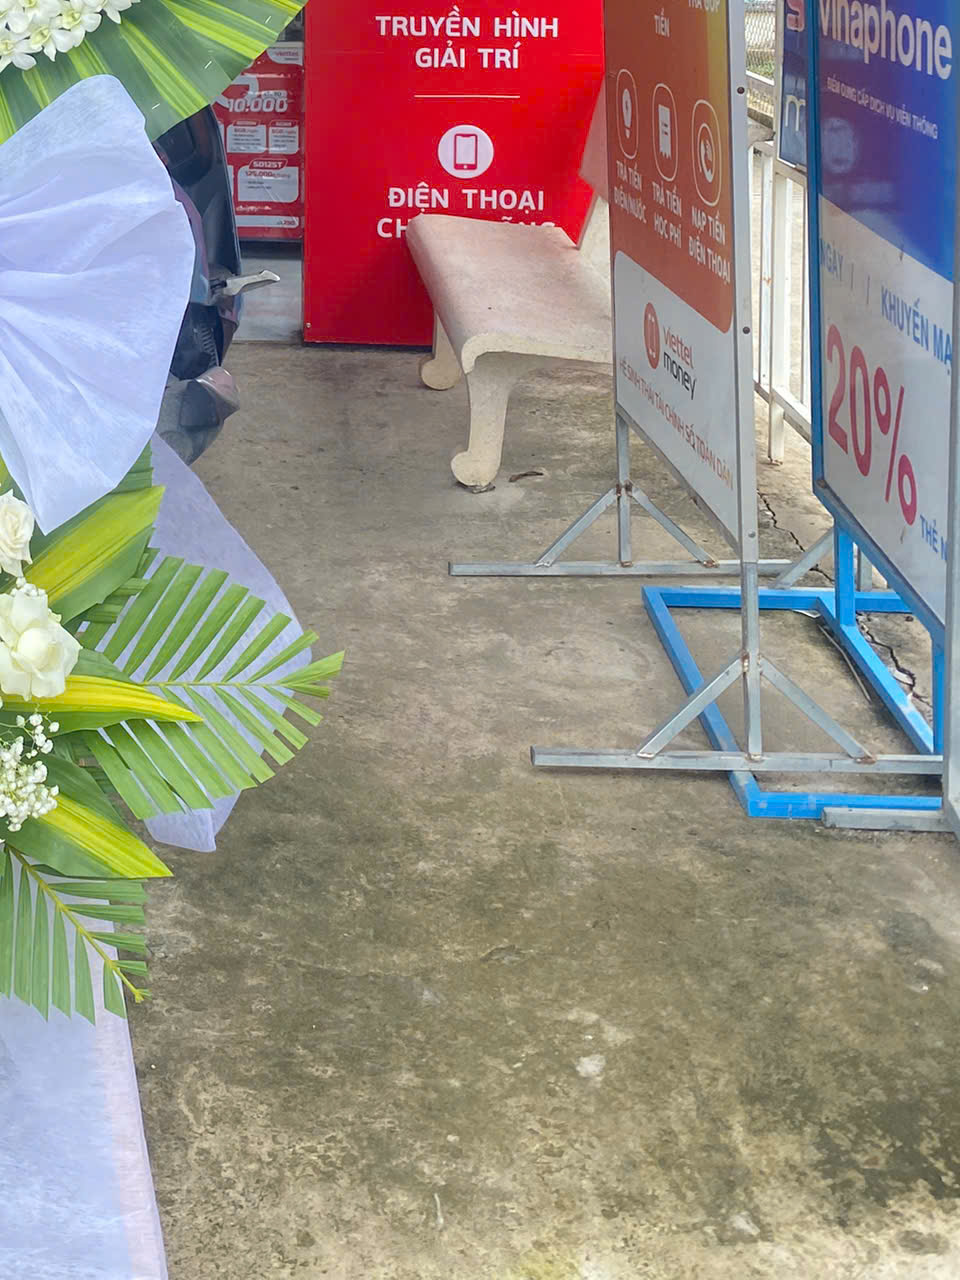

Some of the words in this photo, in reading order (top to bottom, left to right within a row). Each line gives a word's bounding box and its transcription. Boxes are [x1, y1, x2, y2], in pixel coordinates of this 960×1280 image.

[376, 5, 480, 37] TRUYỀN
[494, 10, 559, 38] HÌNH
[415, 40, 465, 69] GIẢI
[477, 41, 522, 69] TRÍ
[388, 182, 450, 213] ĐIỆN
[461, 189, 544, 214] THOẠI
[881, 284, 930, 352] KHUYẾN
[663, 325, 694, 369] viettel
[664, 352, 697, 400] money
[826, 324, 918, 526] 20%
